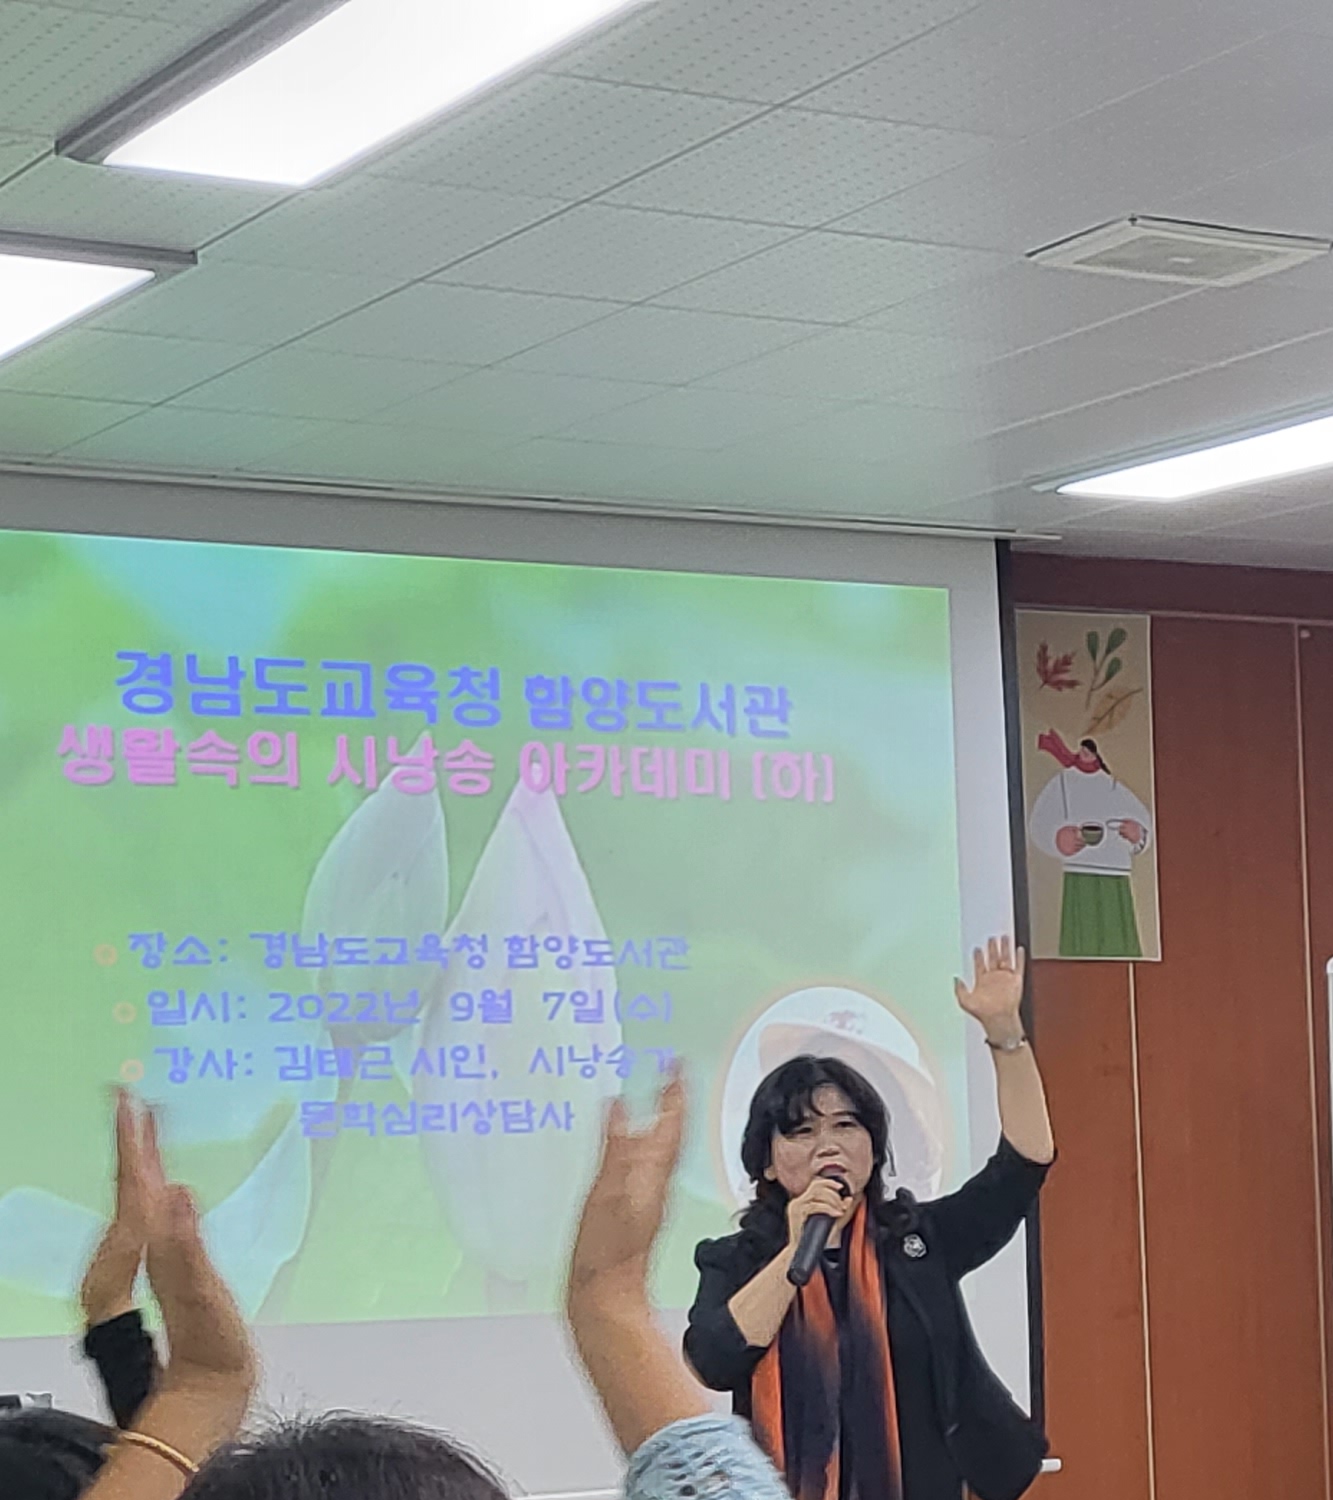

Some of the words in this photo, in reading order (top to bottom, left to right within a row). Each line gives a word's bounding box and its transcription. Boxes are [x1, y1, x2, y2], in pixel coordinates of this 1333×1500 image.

[114, 650, 502, 728] 경남도교육청
[524, 674, 795, 738] 함양도서관
[57, 724, 300, 789] 생활속의
[327, 733, 495, 795] 시낭송
[519, 741, 732, 801] 아카데미
[127, 931, 228, 970] 장소:
[249, 931, 489, 970] 경남도교육청
[503, 933, 692, 971] 함양도서관
[146, 988, 247, 1027] 일시:
[268, 988, 421, 1024] 2022년
[449, 988, 513, 1024] 9월
[153, 1045, 253, 1084] 강사:
[273, 1043, 393, 1082] 김태근
[410, 1043, 499, 1080] 시인,
[300, 1098, 576, 1138] 문학심리상담사
